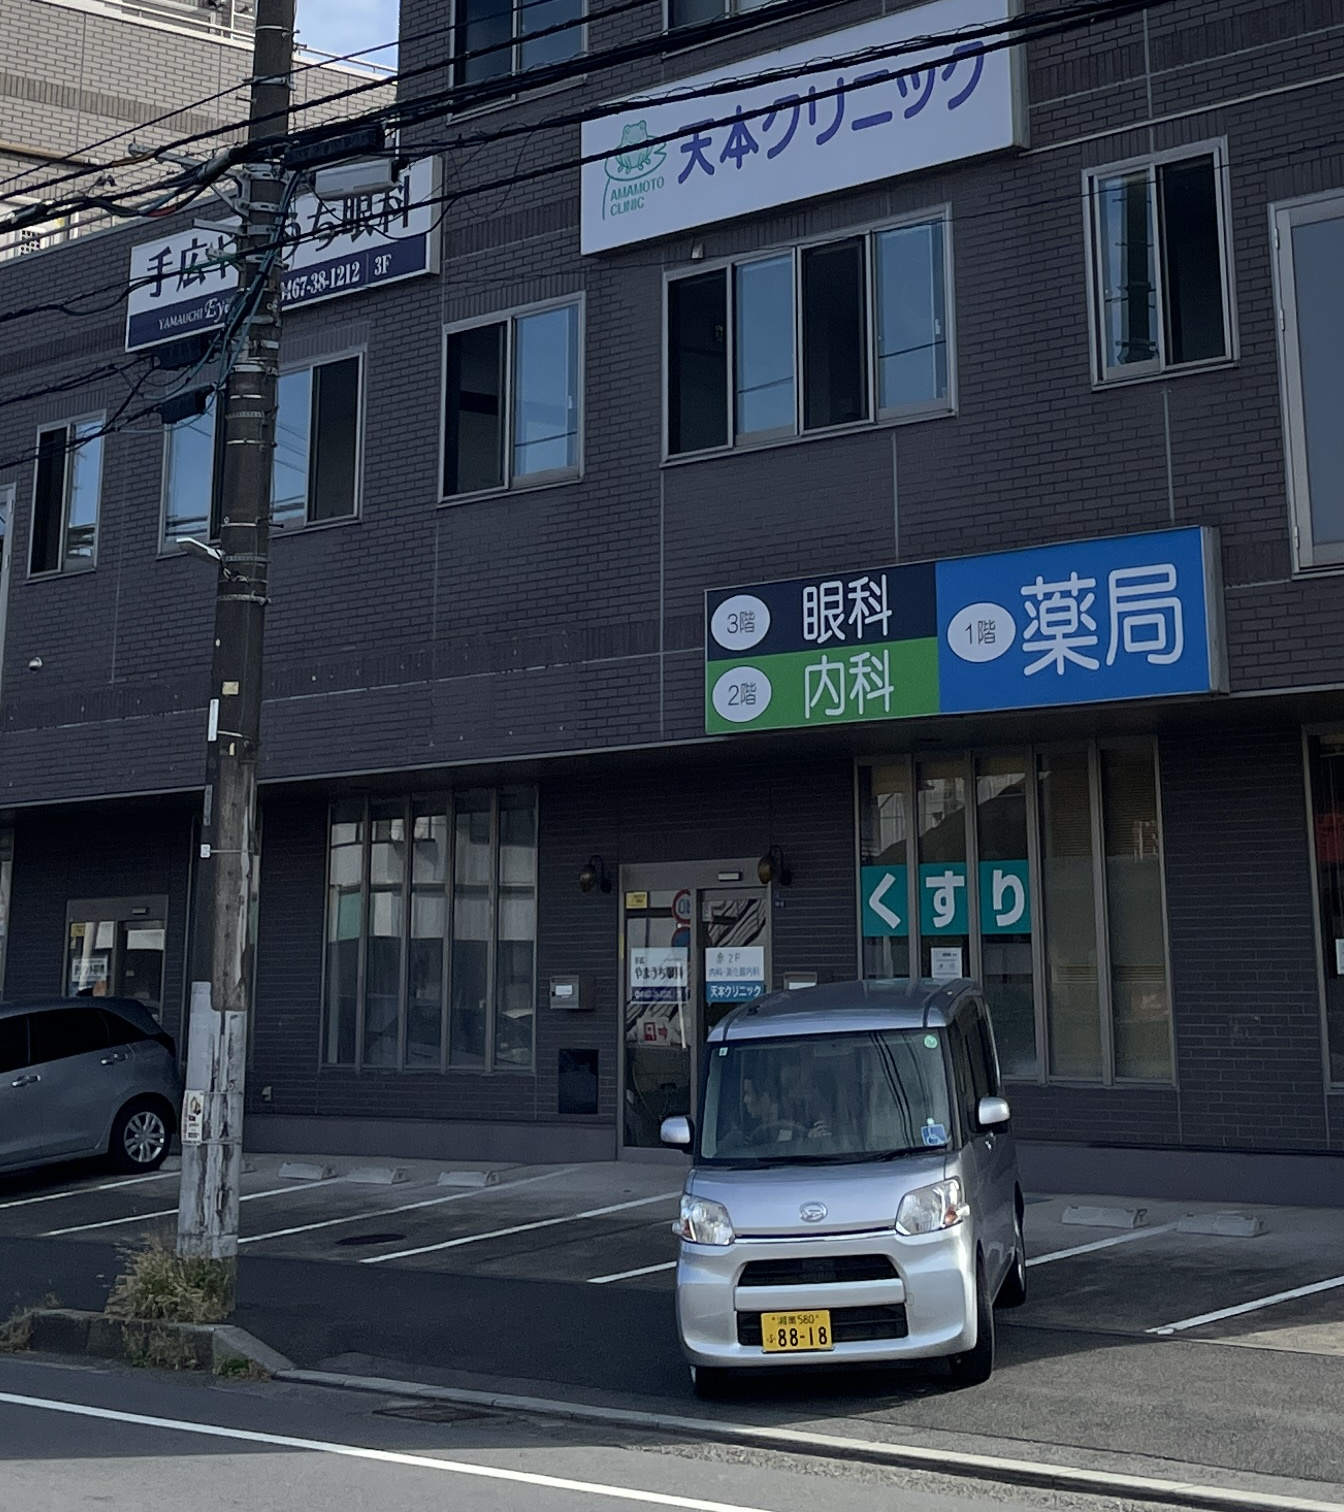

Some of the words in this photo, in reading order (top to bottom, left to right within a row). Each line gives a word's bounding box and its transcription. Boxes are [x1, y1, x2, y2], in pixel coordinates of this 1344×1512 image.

[677, 40, 985, 185] 天本クリニック
[609, 176, 665, 201] AMAMOTO
[609, 197, 645, 217] CLINIC
[158, 307, 204, 331] YAMAUCHI
[373, 253, 393, 276] 3F
[726, 609, 756, 636] 3階
[802, 573, 893, 644] 眼科
[964, 619, 997, 646] 1階
[1020, 562, 1184, 677] 薬局
[727, 682, 757, 708] 2階
[805, 648, 895, 720] 内科
[868, 869, 1025, 930] くすり
[710, 985, 762, 997] 天本クリニック
[778, 1326, 828, 1347] 88-18
